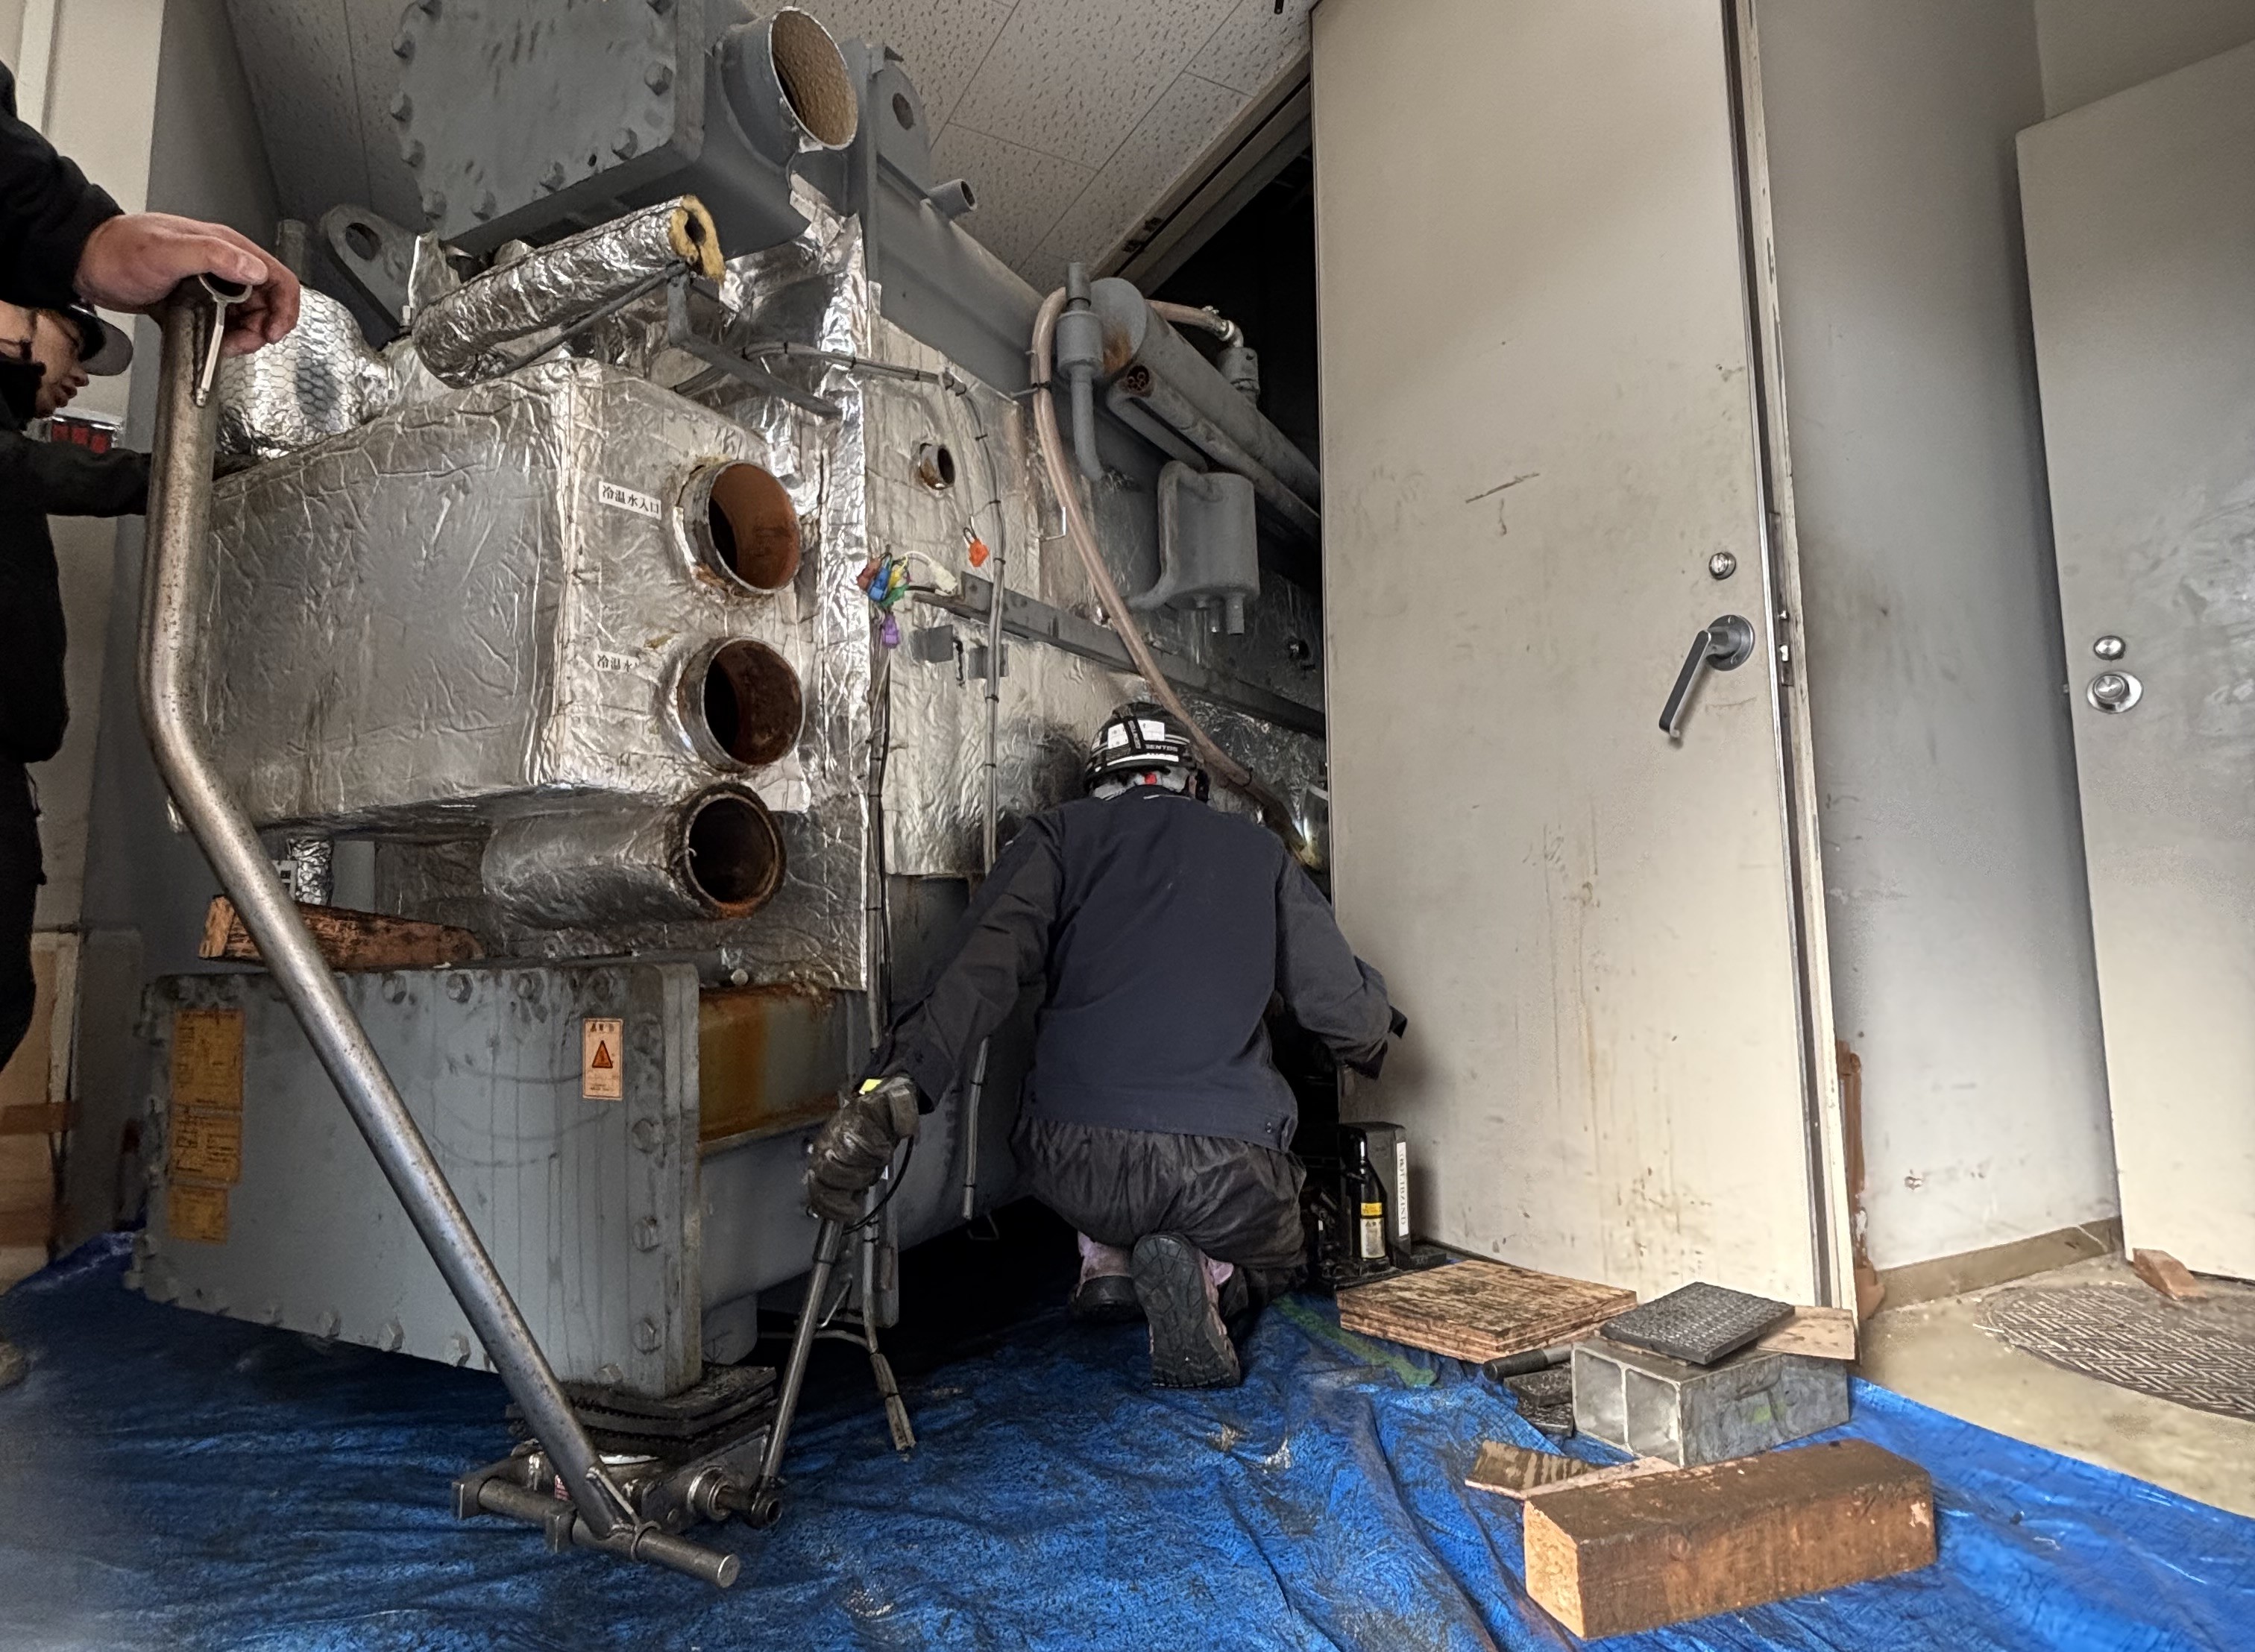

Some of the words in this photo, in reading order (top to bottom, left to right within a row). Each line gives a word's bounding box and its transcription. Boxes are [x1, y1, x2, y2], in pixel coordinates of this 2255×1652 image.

[602, 485, 659, 514] 冷温水入口
[597, 655, 639, 672] 冷温水
